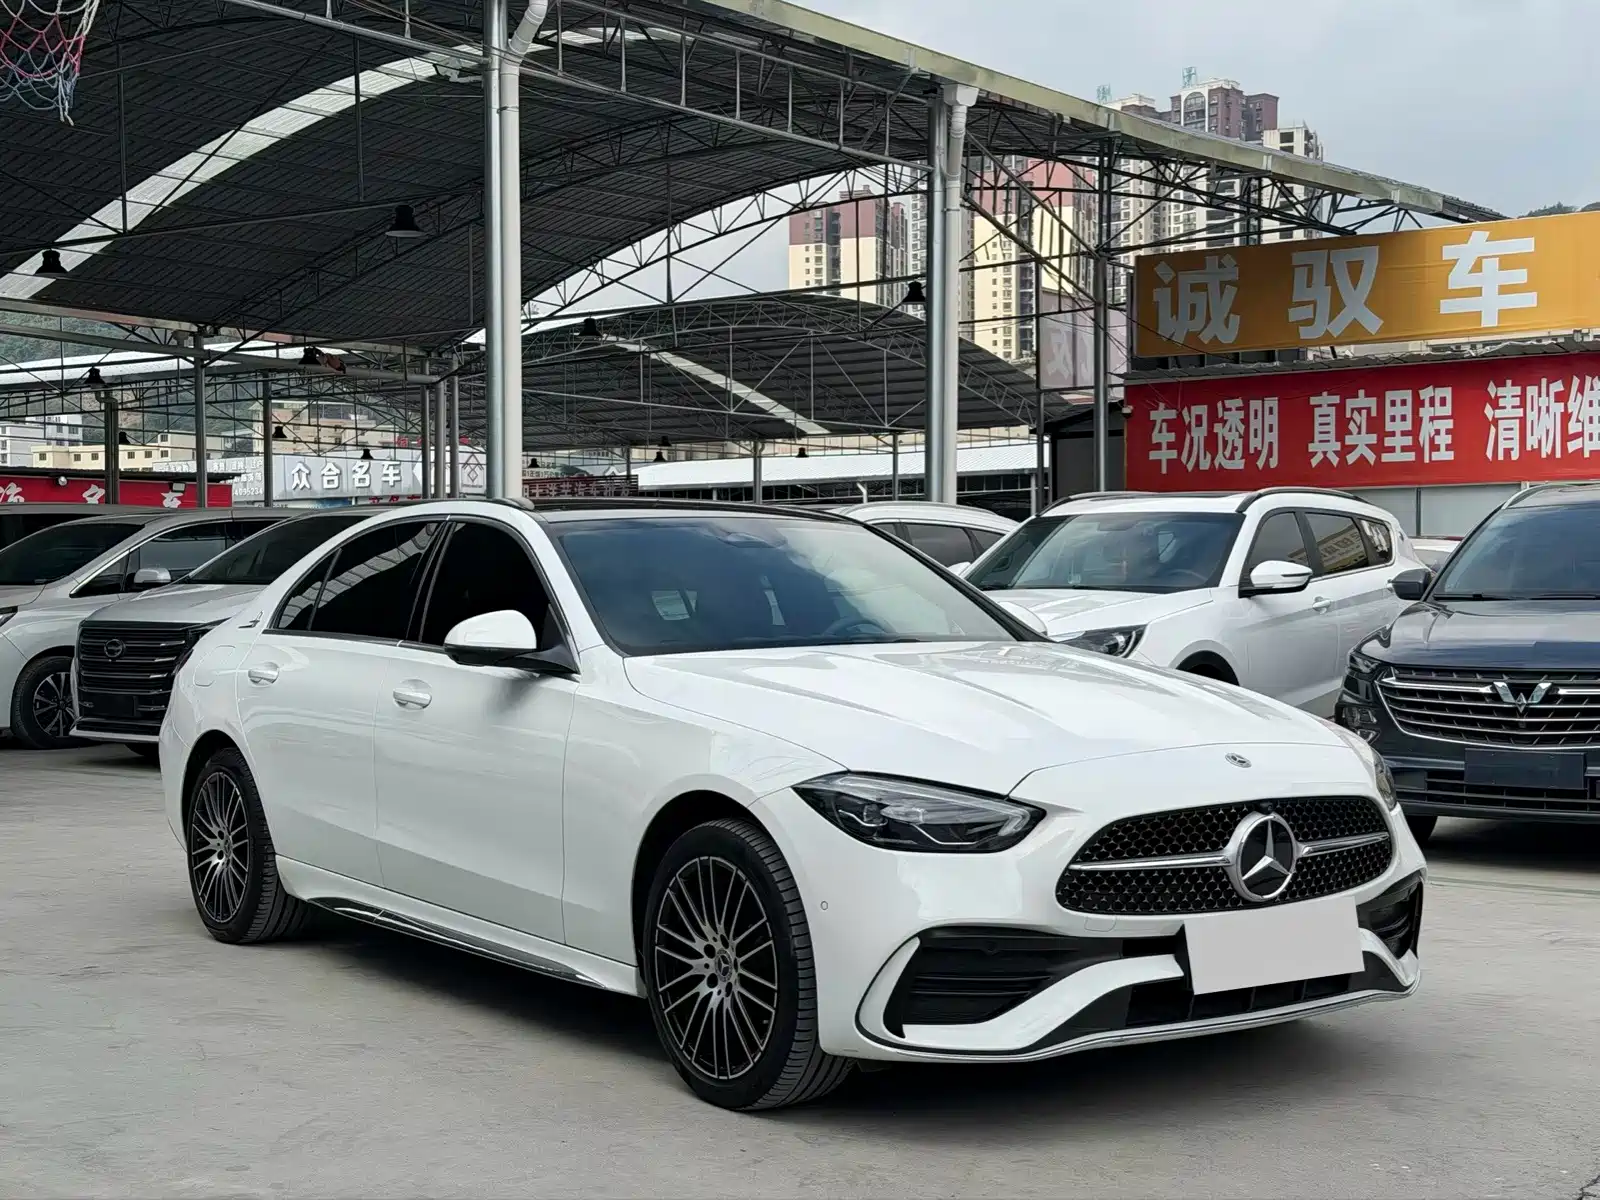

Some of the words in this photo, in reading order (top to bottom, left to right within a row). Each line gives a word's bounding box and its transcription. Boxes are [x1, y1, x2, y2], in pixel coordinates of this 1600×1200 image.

[1153, 230, 1538, 344] 诚驭车
[1149, 397, 1279, 474] 车况透明
[1308, 385, 1454, 468] 真实里程
[1484, 375, 1600, 462] 清晰维
[291, 461, 402, 490] 众合名车
